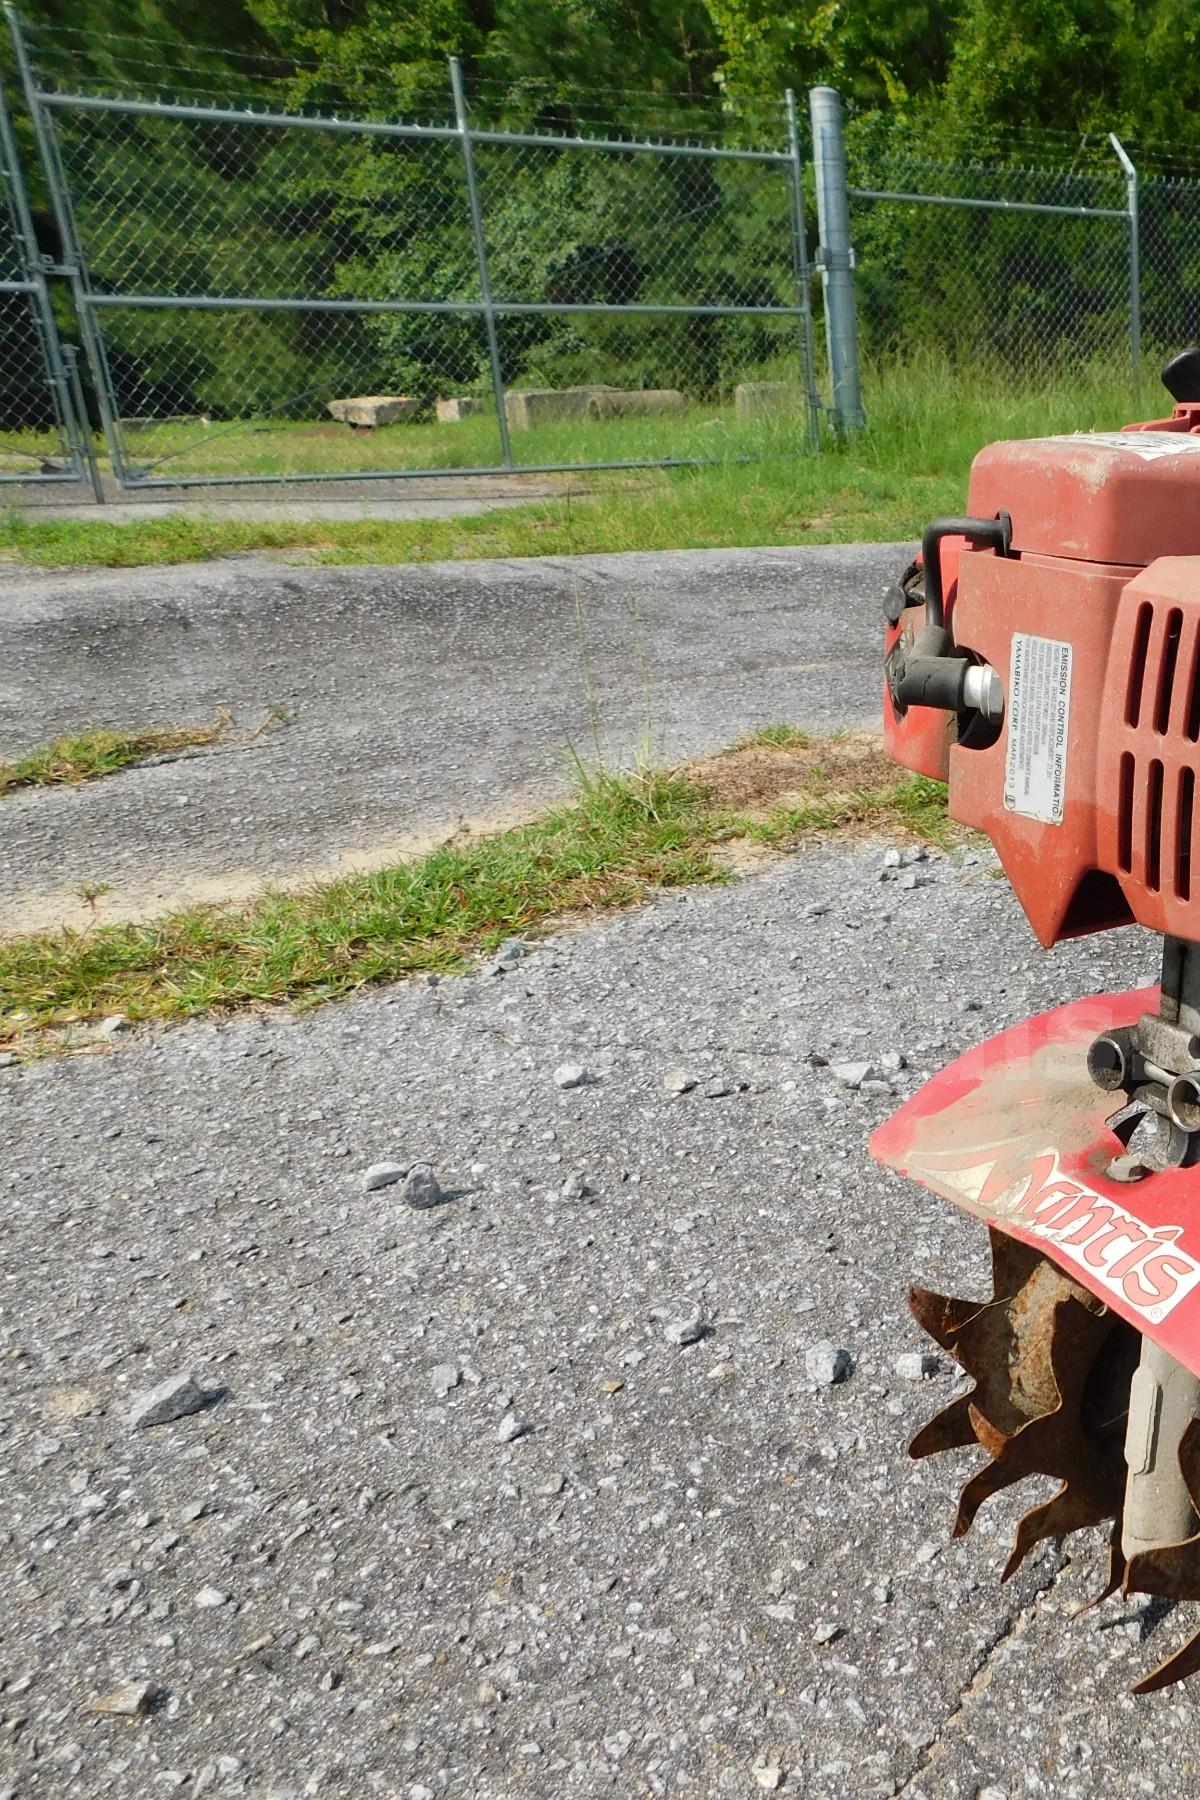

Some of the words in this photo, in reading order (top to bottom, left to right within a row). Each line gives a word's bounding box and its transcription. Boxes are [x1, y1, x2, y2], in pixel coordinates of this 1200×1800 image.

[1012, 638, 1023, 698] YAMABIKO
[1058, 646, 1069, 696] EMISSION
[1055, 699, 1066, 749] CONTROL
[908, 1147, 1196, 1308] Mantis
